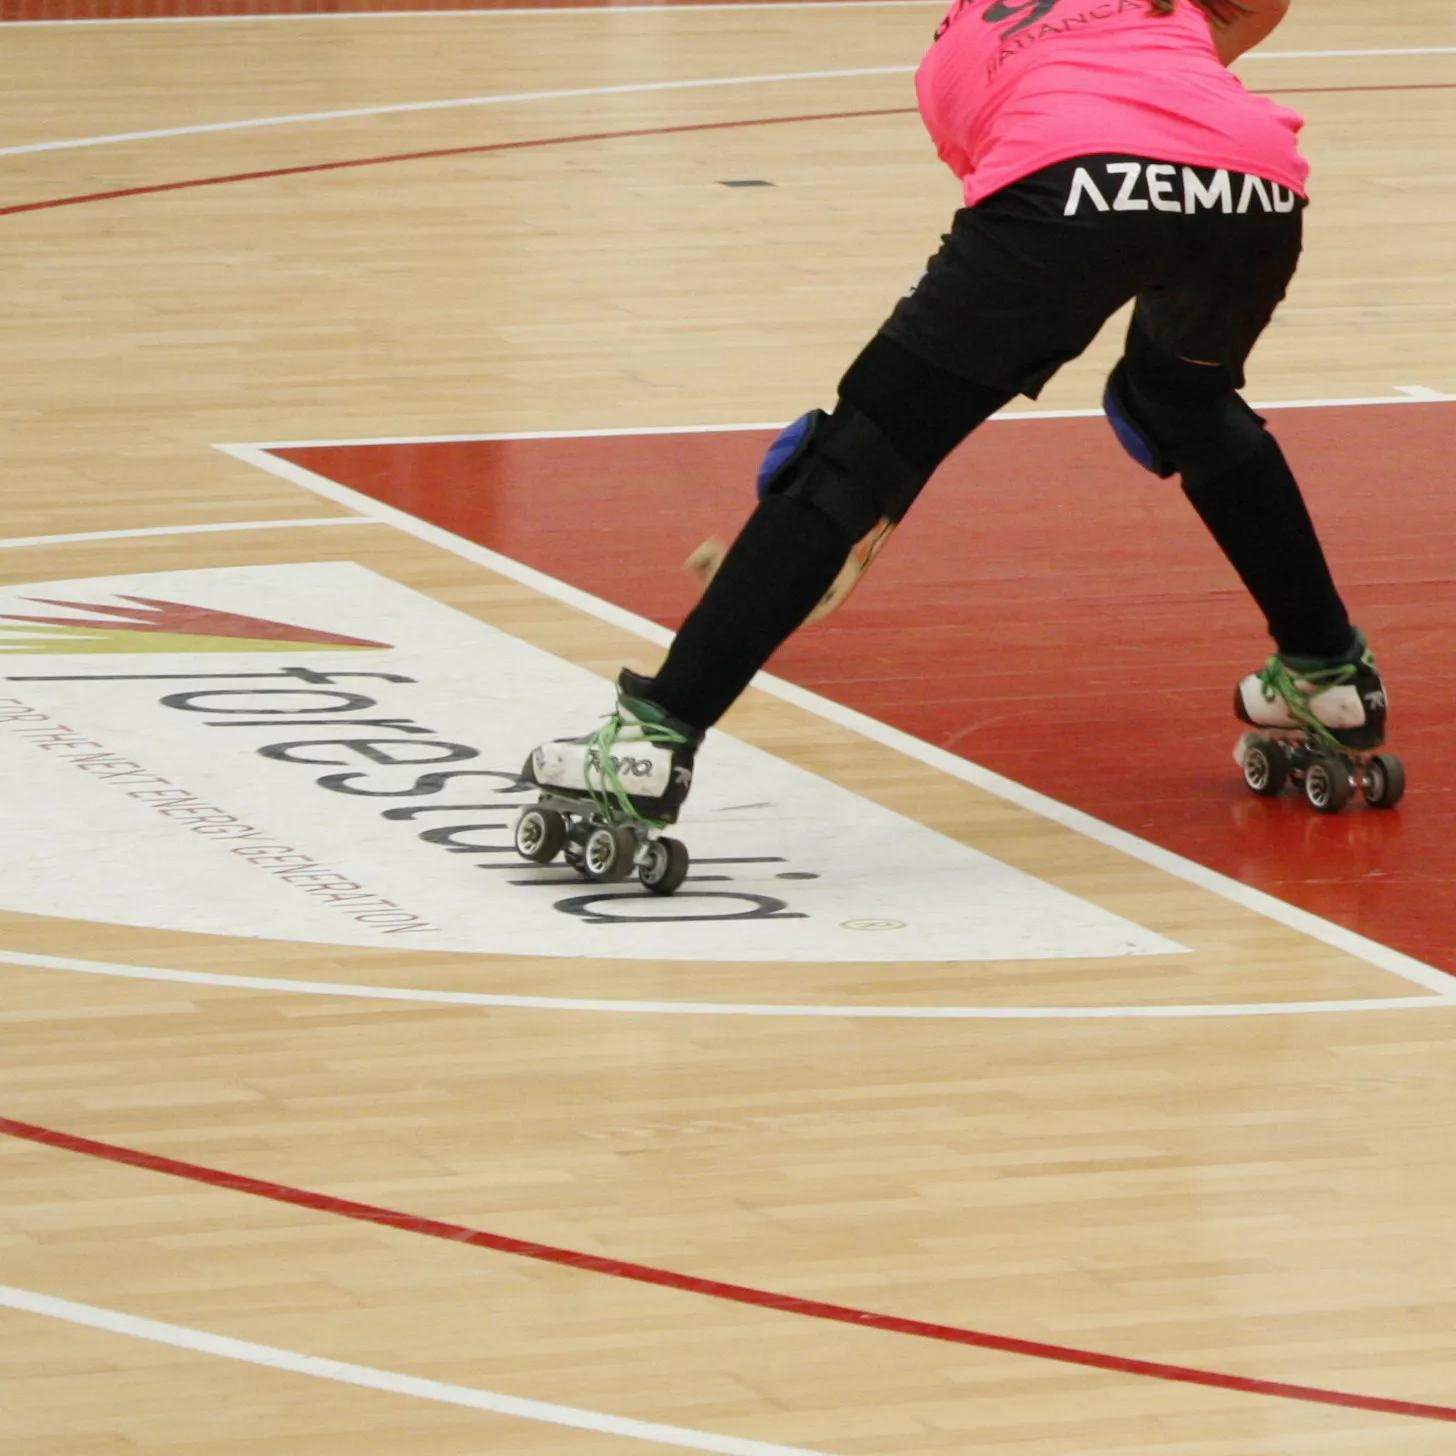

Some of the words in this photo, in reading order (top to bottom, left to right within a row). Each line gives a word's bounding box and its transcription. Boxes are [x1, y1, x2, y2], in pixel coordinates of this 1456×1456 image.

[1064, 161, 1295, 216] AZEMAD
[10, 724, 104, 751] THE
[57, 751, 171, 785] NEXT
[126, 788, 275, 841] ENERGY
[231, 845, 442, 934] GENERATION
